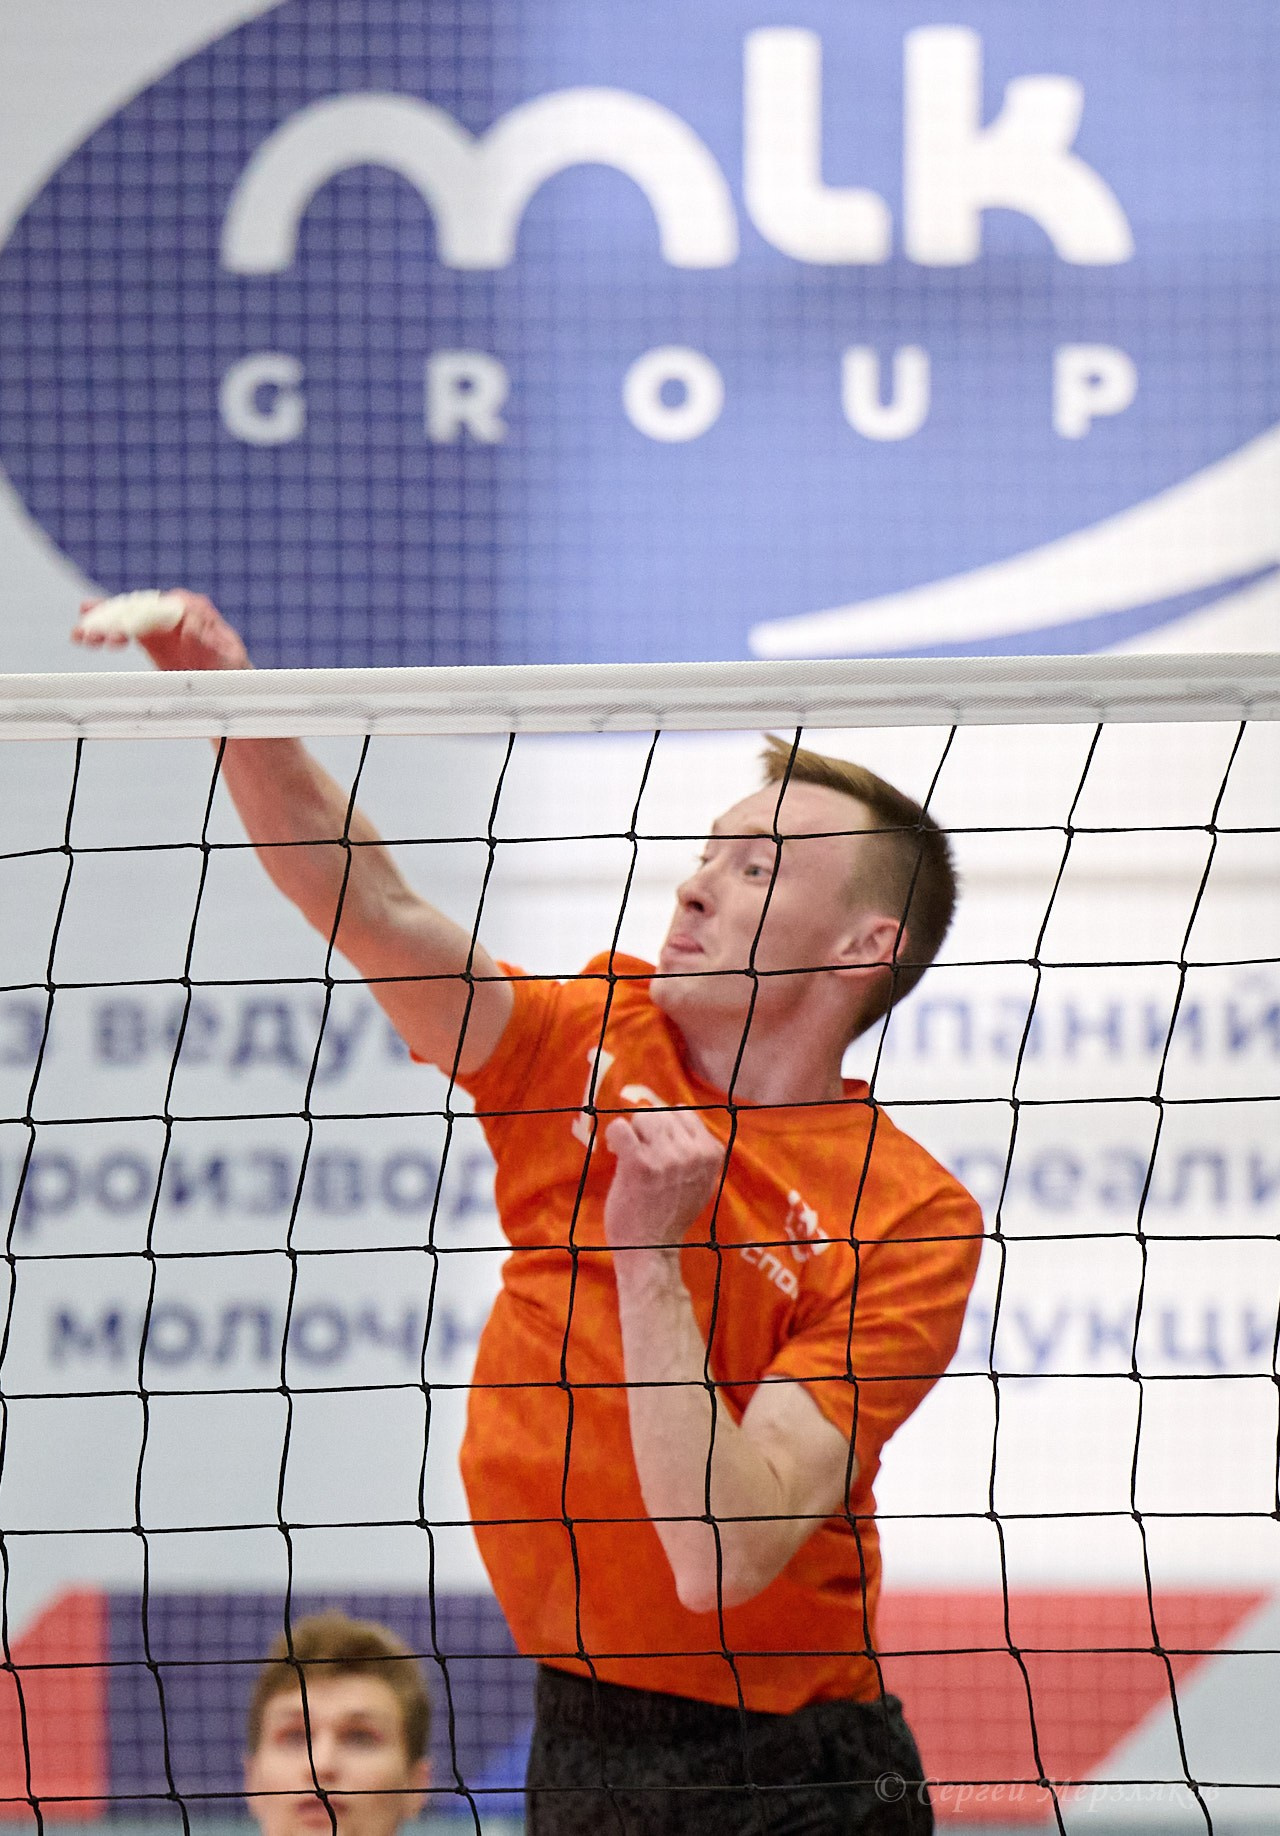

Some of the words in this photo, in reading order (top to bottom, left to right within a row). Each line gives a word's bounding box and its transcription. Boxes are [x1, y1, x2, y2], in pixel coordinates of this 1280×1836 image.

[219, 343, 1139, 444] GROUP
[94, 1009, 410, 1086] веду
[883, 973, 1280, 1060] паний
[740, 1240, 800, 1302] СПО
[51, 1304, 483, 1370] молочн
